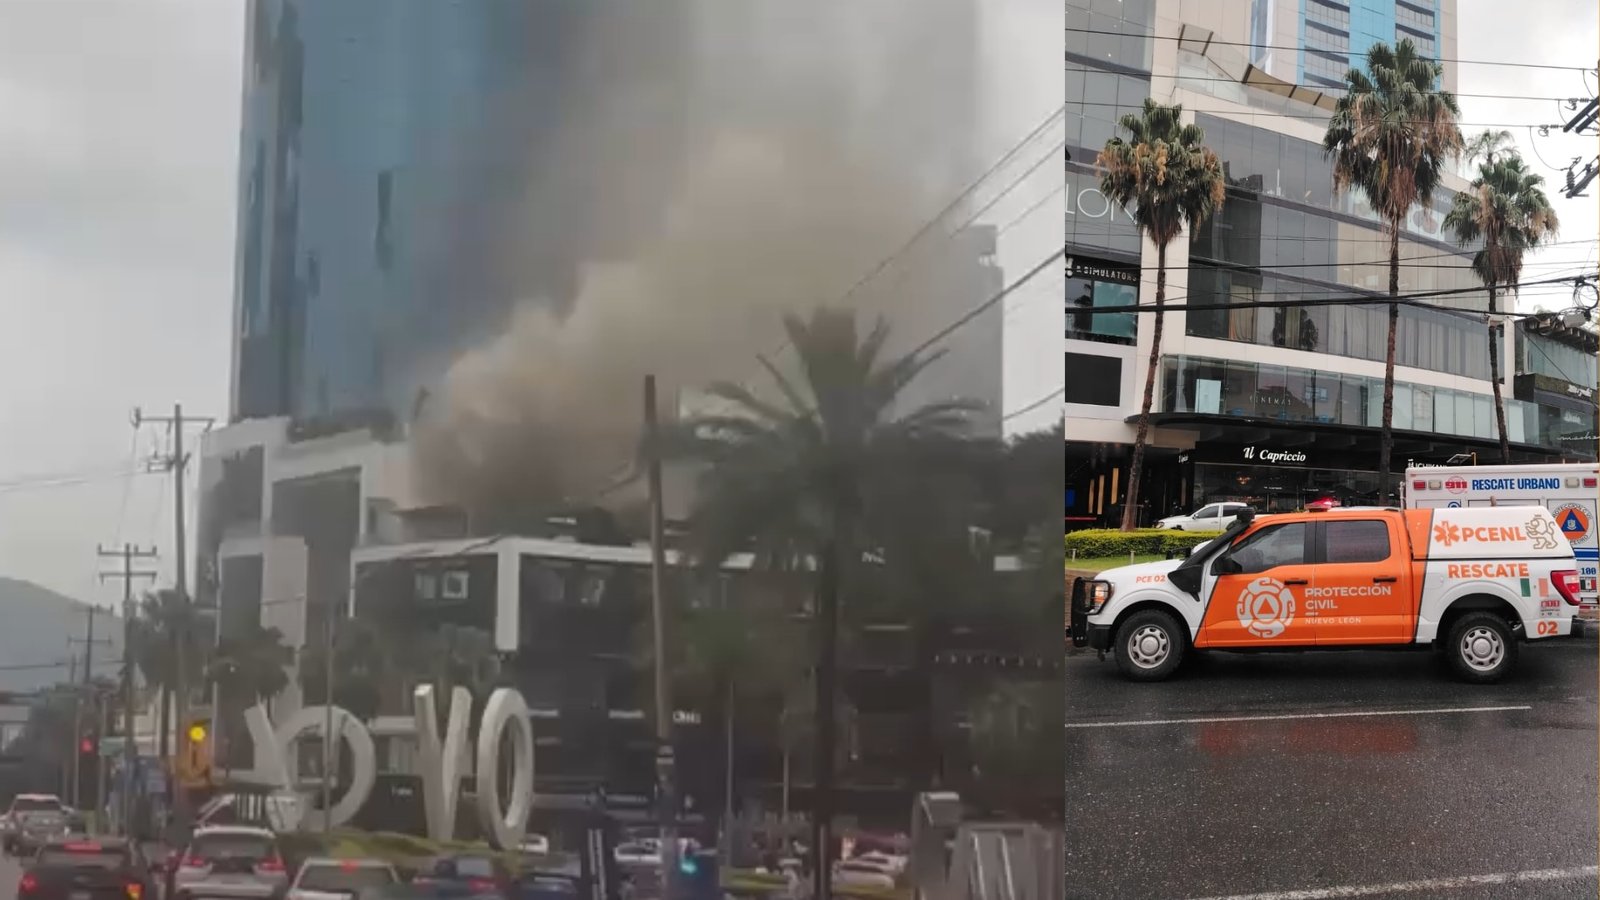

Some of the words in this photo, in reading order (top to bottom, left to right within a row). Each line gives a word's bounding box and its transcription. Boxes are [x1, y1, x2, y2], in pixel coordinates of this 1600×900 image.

[1243, 446, 1255, 459] Il
[1260, 449, 1306, 463] Capriccio
[1445, 481, 1467, 489] 911
[1472, 479, 1515, 490] RESCATE
[1517, 478, 1560, 489] URBANO
[1462, 527, 1526, 542] PCENL
[1136, 575, 1152, 583] PCE
[1154, 574, 1166, 582] 02
[1448, 563, 1530, 579] RESCATE
[1304, 582, 1392, 598] PROTECCIÓN
[1305, 599, 1338, 610] CIVIL
[1305, 617, 1335, 625] NUEVO
[1537, 620, 1558, 635] 02
